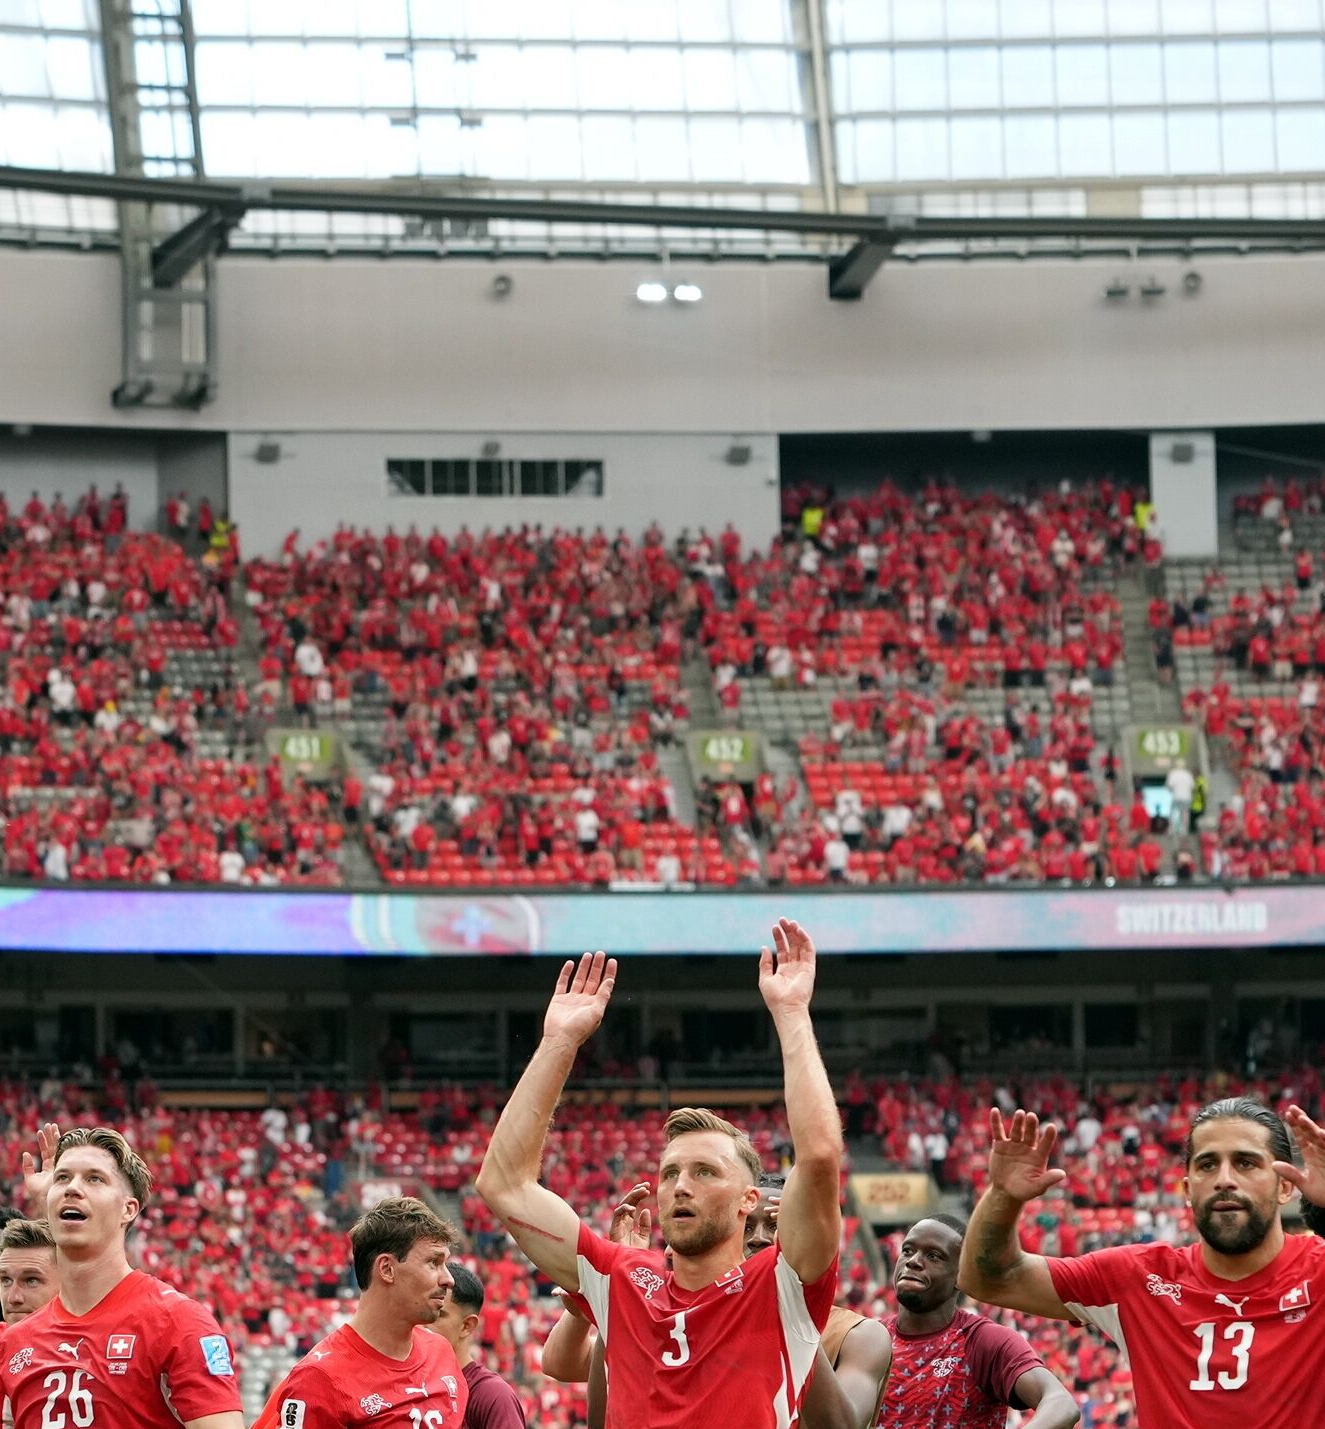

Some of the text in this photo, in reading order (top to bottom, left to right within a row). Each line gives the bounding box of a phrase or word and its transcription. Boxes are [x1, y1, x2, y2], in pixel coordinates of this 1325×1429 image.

[1117, 903, 1266, 933] SWITZERLAND
[661, 1311, 690, 1367] 3
[1189, 1321, 1255, 1391] 13
